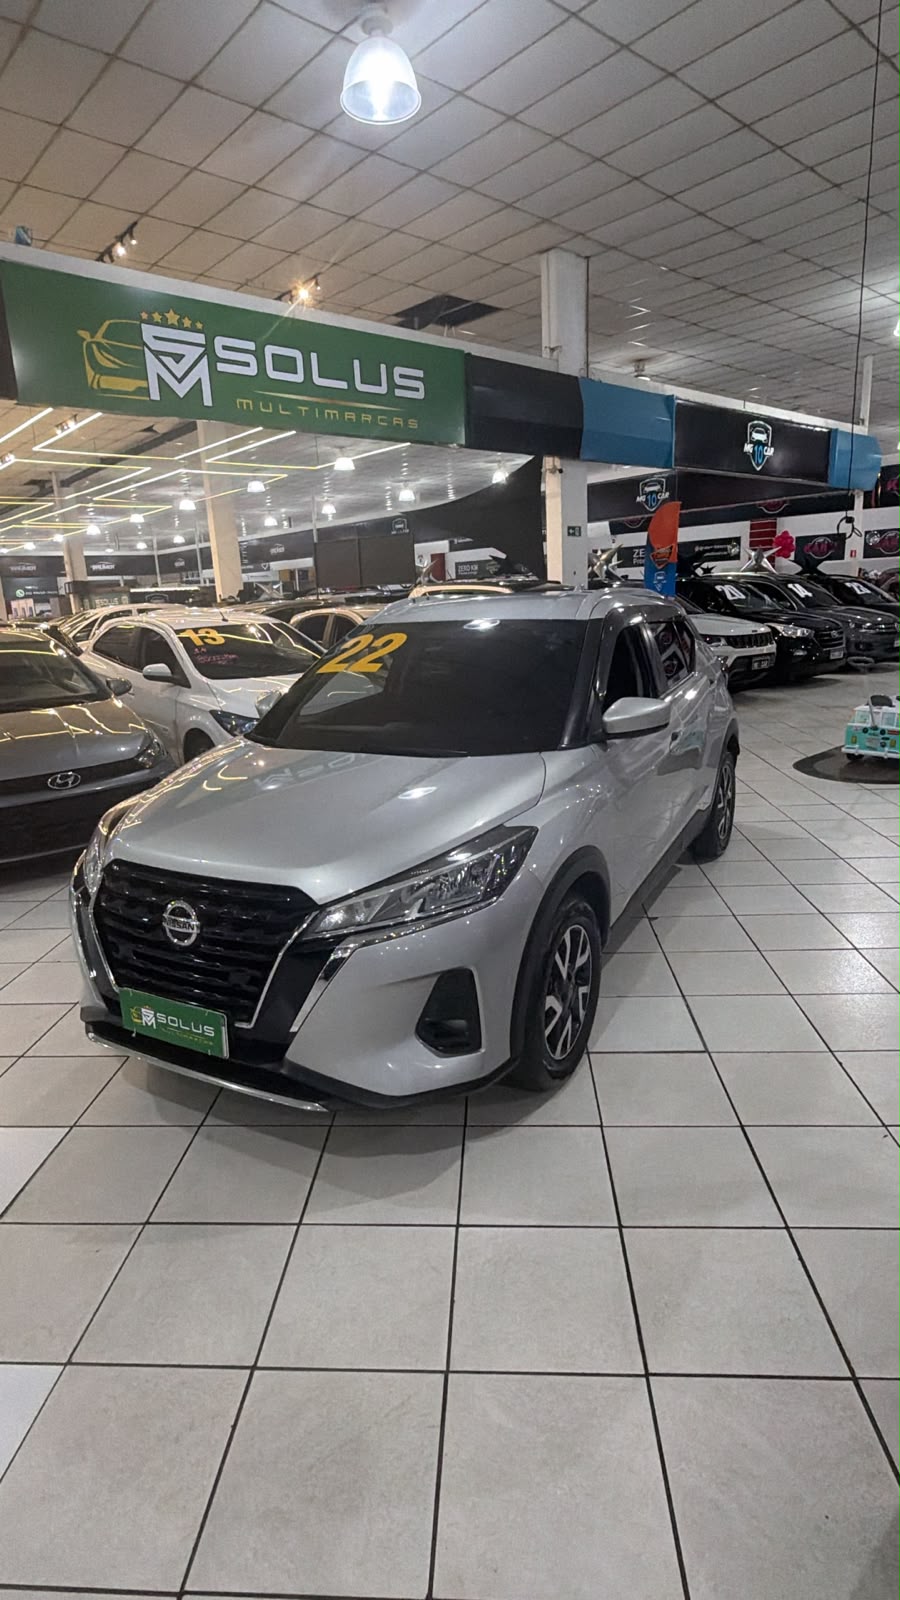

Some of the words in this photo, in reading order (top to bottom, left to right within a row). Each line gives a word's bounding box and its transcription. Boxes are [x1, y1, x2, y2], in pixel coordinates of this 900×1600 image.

[213, 335, 426, 401] SOLUS
[235, 398, 419, 430] MULTIMARCAS
[743, 442, 754, 454] MG
[754, 444, 764, 465] 10
[763, 446, 775, 456] CAR
[646, 494, 657, 507] 10
[657, 491, 670, 501] CAR
[714, 584, 746, 601] 20
[786, 582, 813, 599] 14
[180, 628, 225, 647] 13
[315, 632, 408, 674] 22
[165, 916, 197, 932] NISSAN
[156, 1012, 216, 1038] SOLUS
